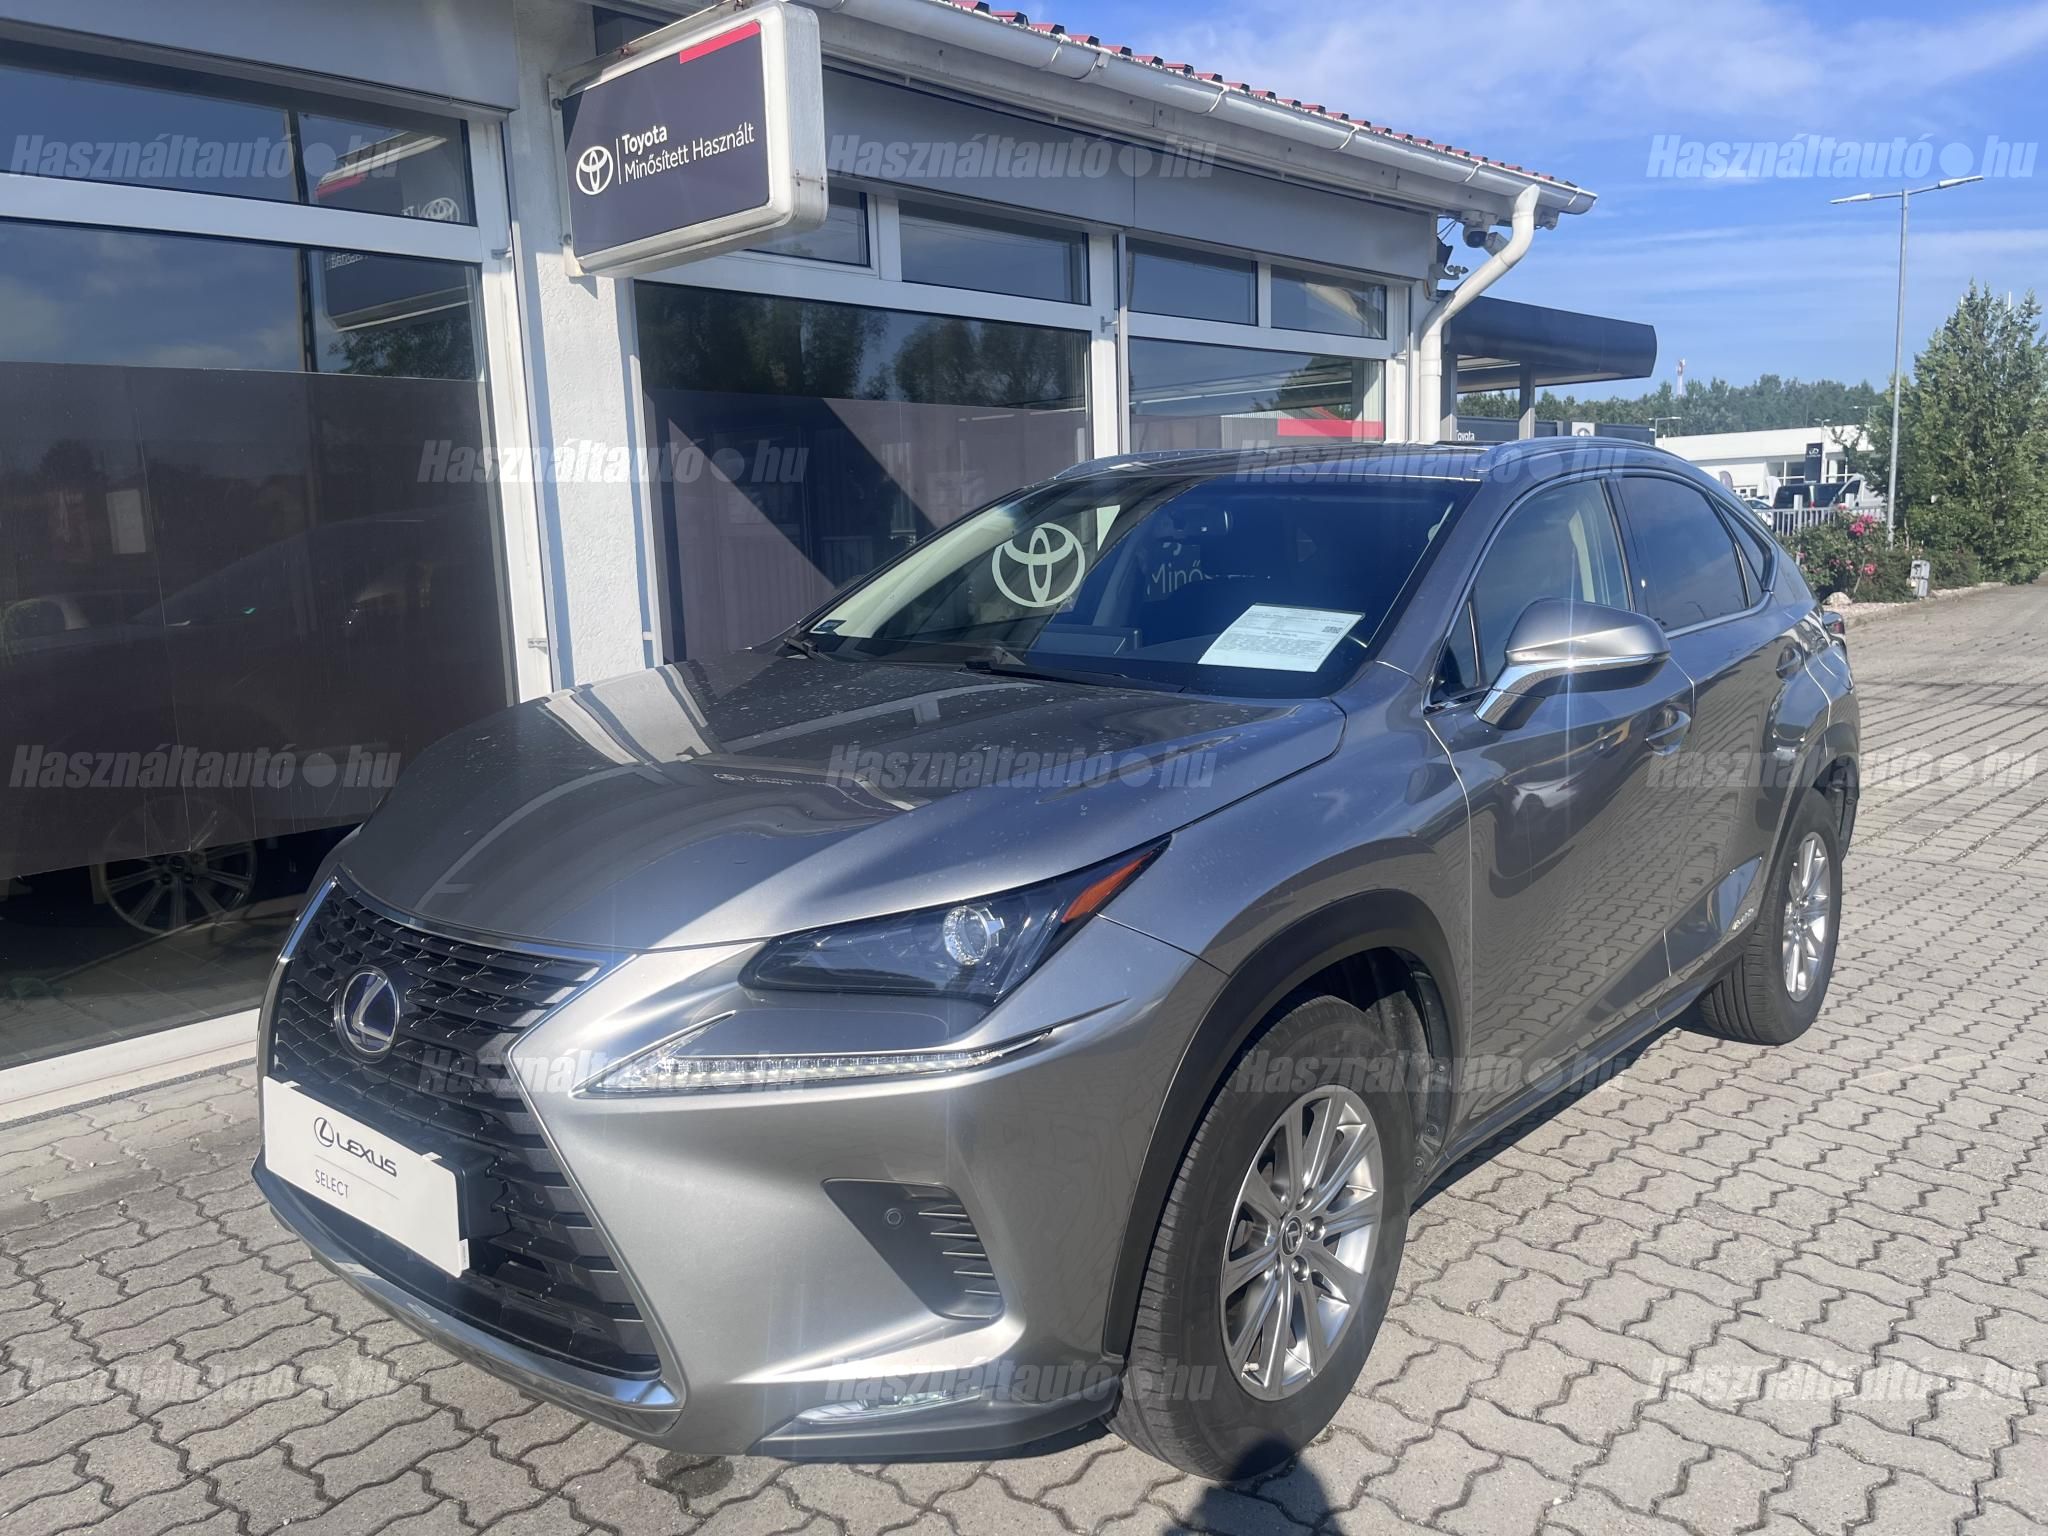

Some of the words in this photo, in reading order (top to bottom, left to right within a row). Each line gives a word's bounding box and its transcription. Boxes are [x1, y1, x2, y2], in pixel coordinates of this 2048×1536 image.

[621, 125, 668, 155] Toyota
[624, 144, 690, 182] Minősített
[692, 122, 755, 161] Használt
[336, 1132, 397, 1177] LEXUS
[315, 1168, 349, 1199] SELECT
